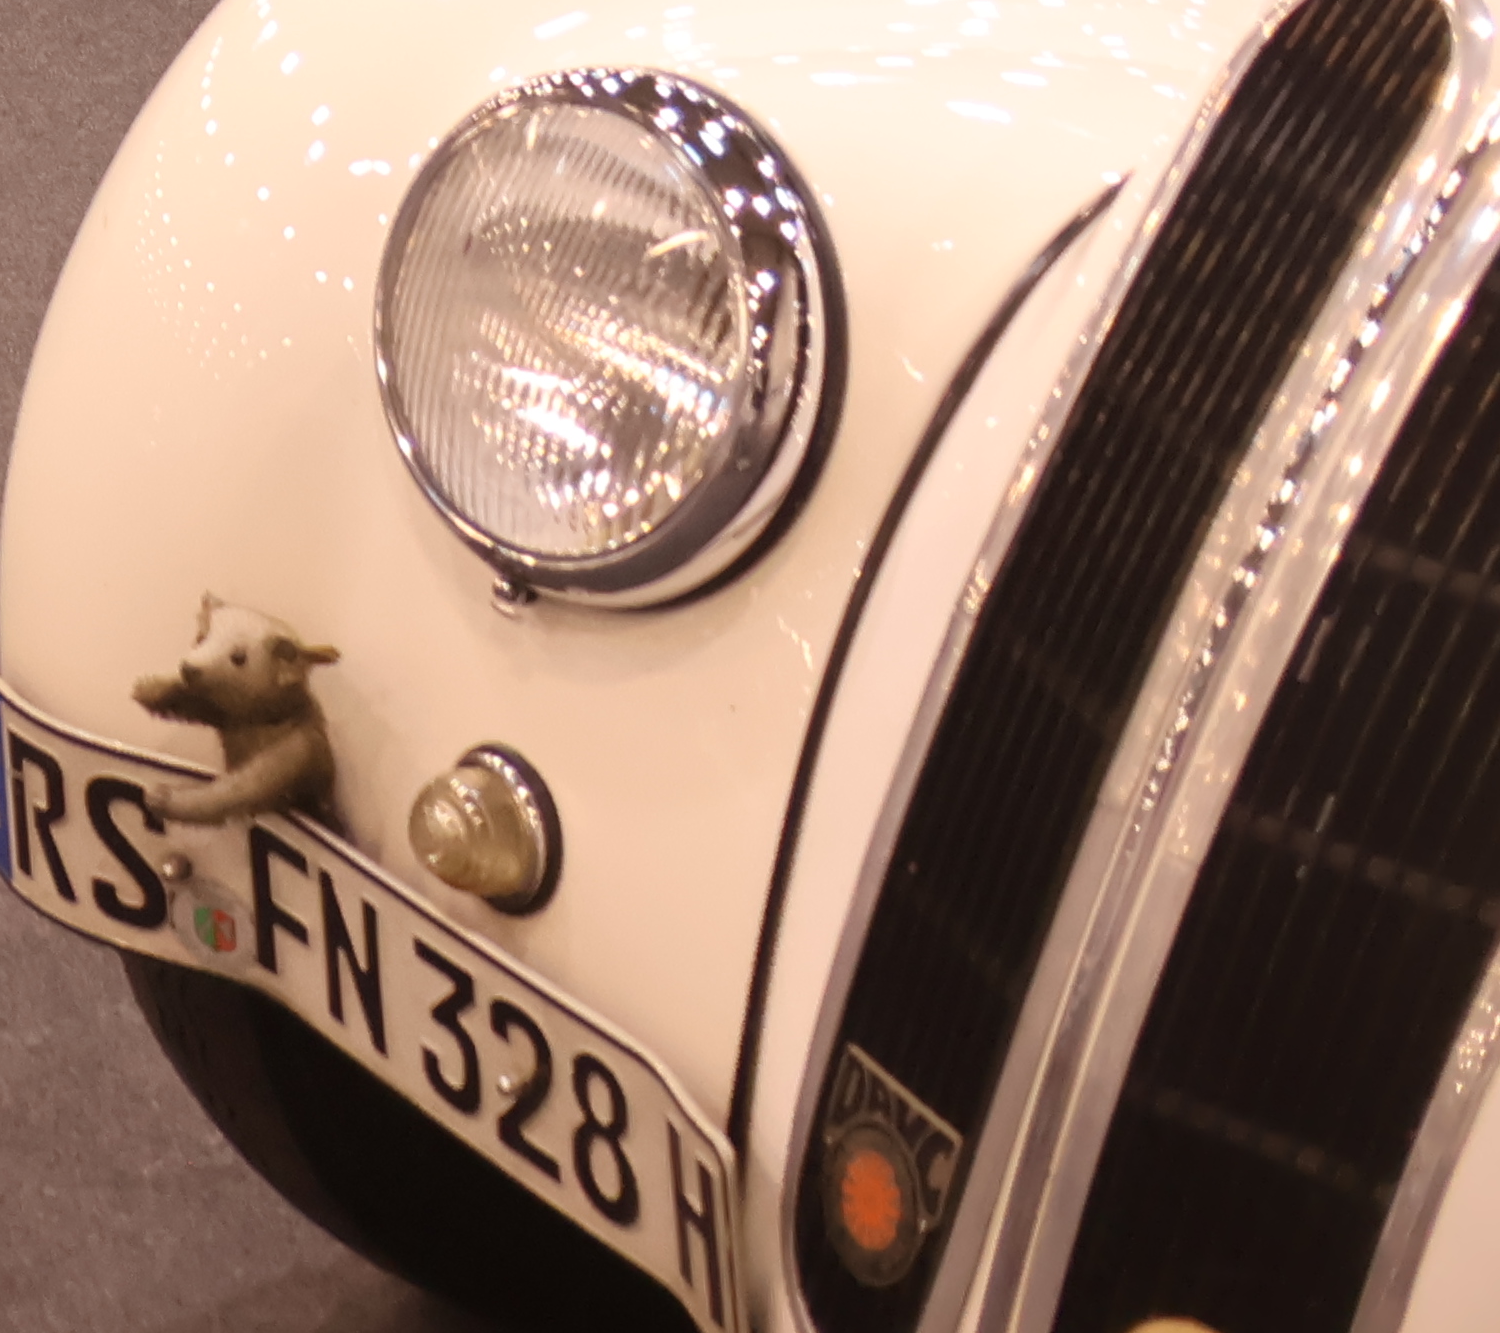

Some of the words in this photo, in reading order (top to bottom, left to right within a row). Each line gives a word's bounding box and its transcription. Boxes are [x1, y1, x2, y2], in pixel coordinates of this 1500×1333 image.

[7, 728, 169, 930] RS
[249, 823, 389, 1058] FN
[413, 937, 640, 1229] 328
[666, 1115, 726, 1331] H
